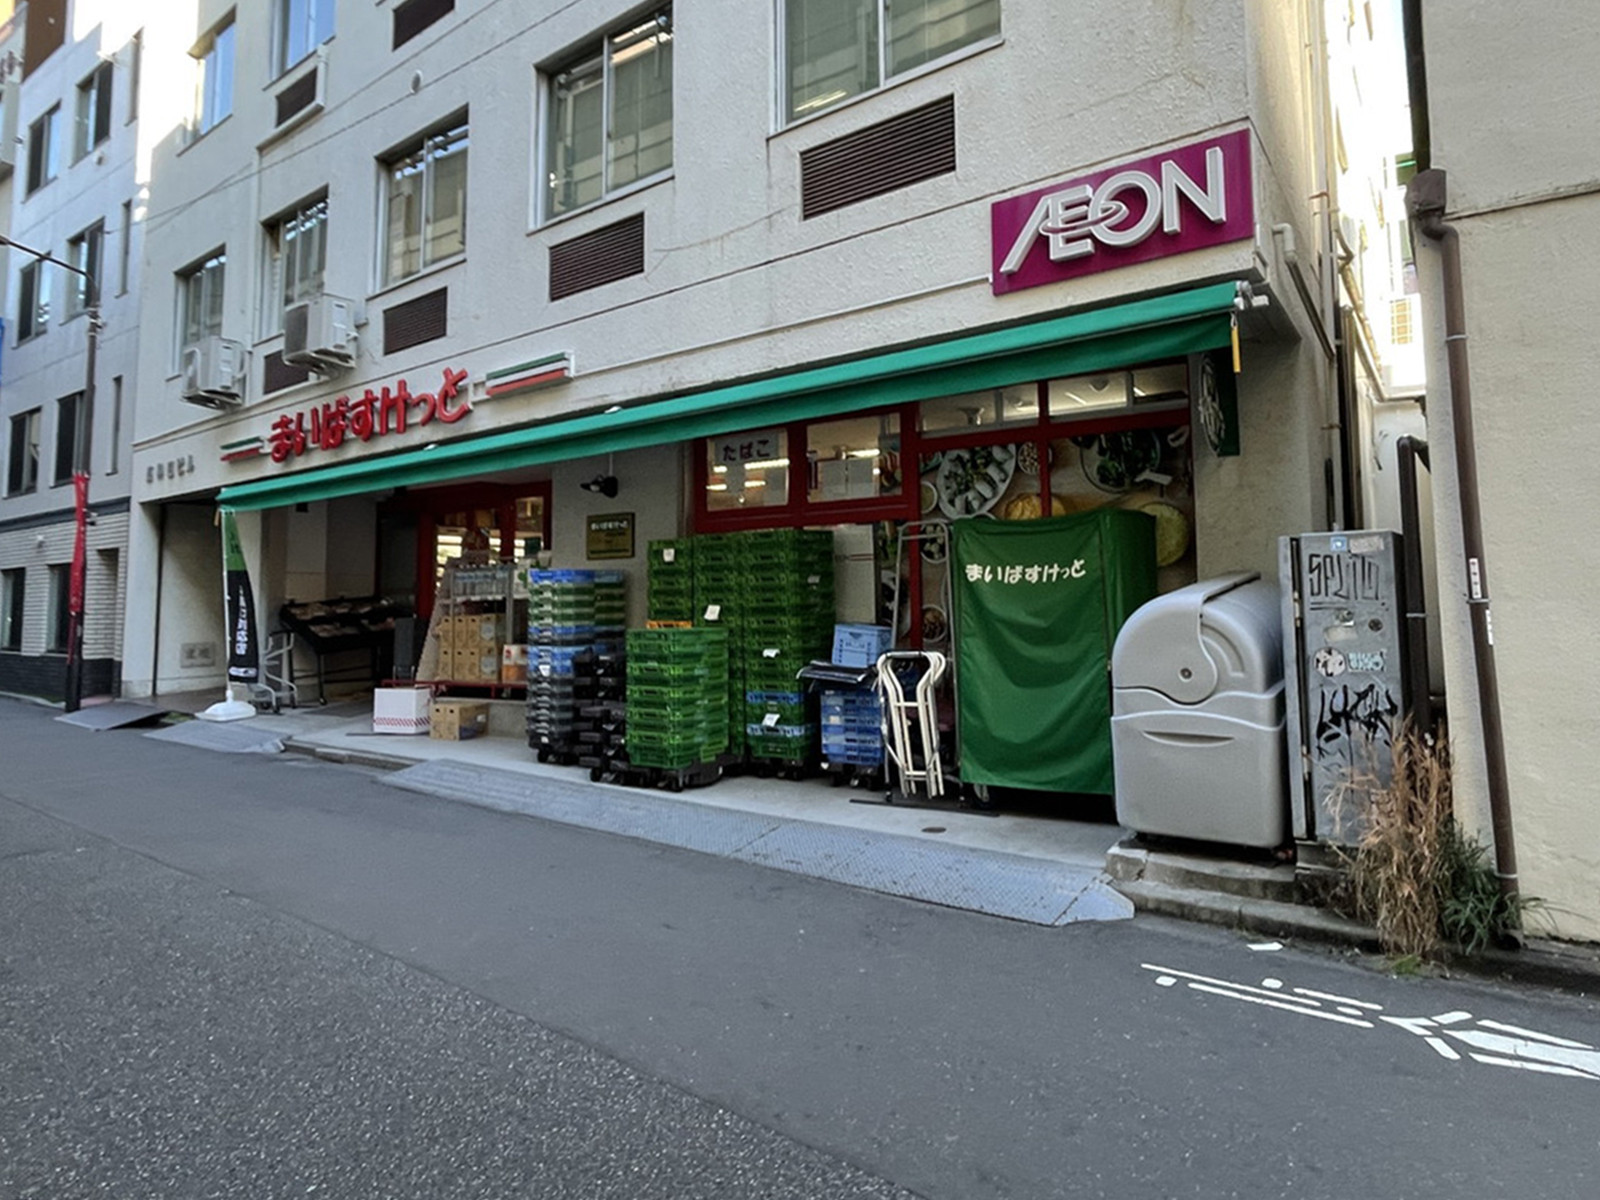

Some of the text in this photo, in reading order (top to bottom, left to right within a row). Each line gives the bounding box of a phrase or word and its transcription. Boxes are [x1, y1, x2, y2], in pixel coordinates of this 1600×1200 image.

[269, 367, 472, 463] まいばすけっと
[723, 440, 770, 461] たばこ
[965, 559, 1086, 584] まいばすけっと
